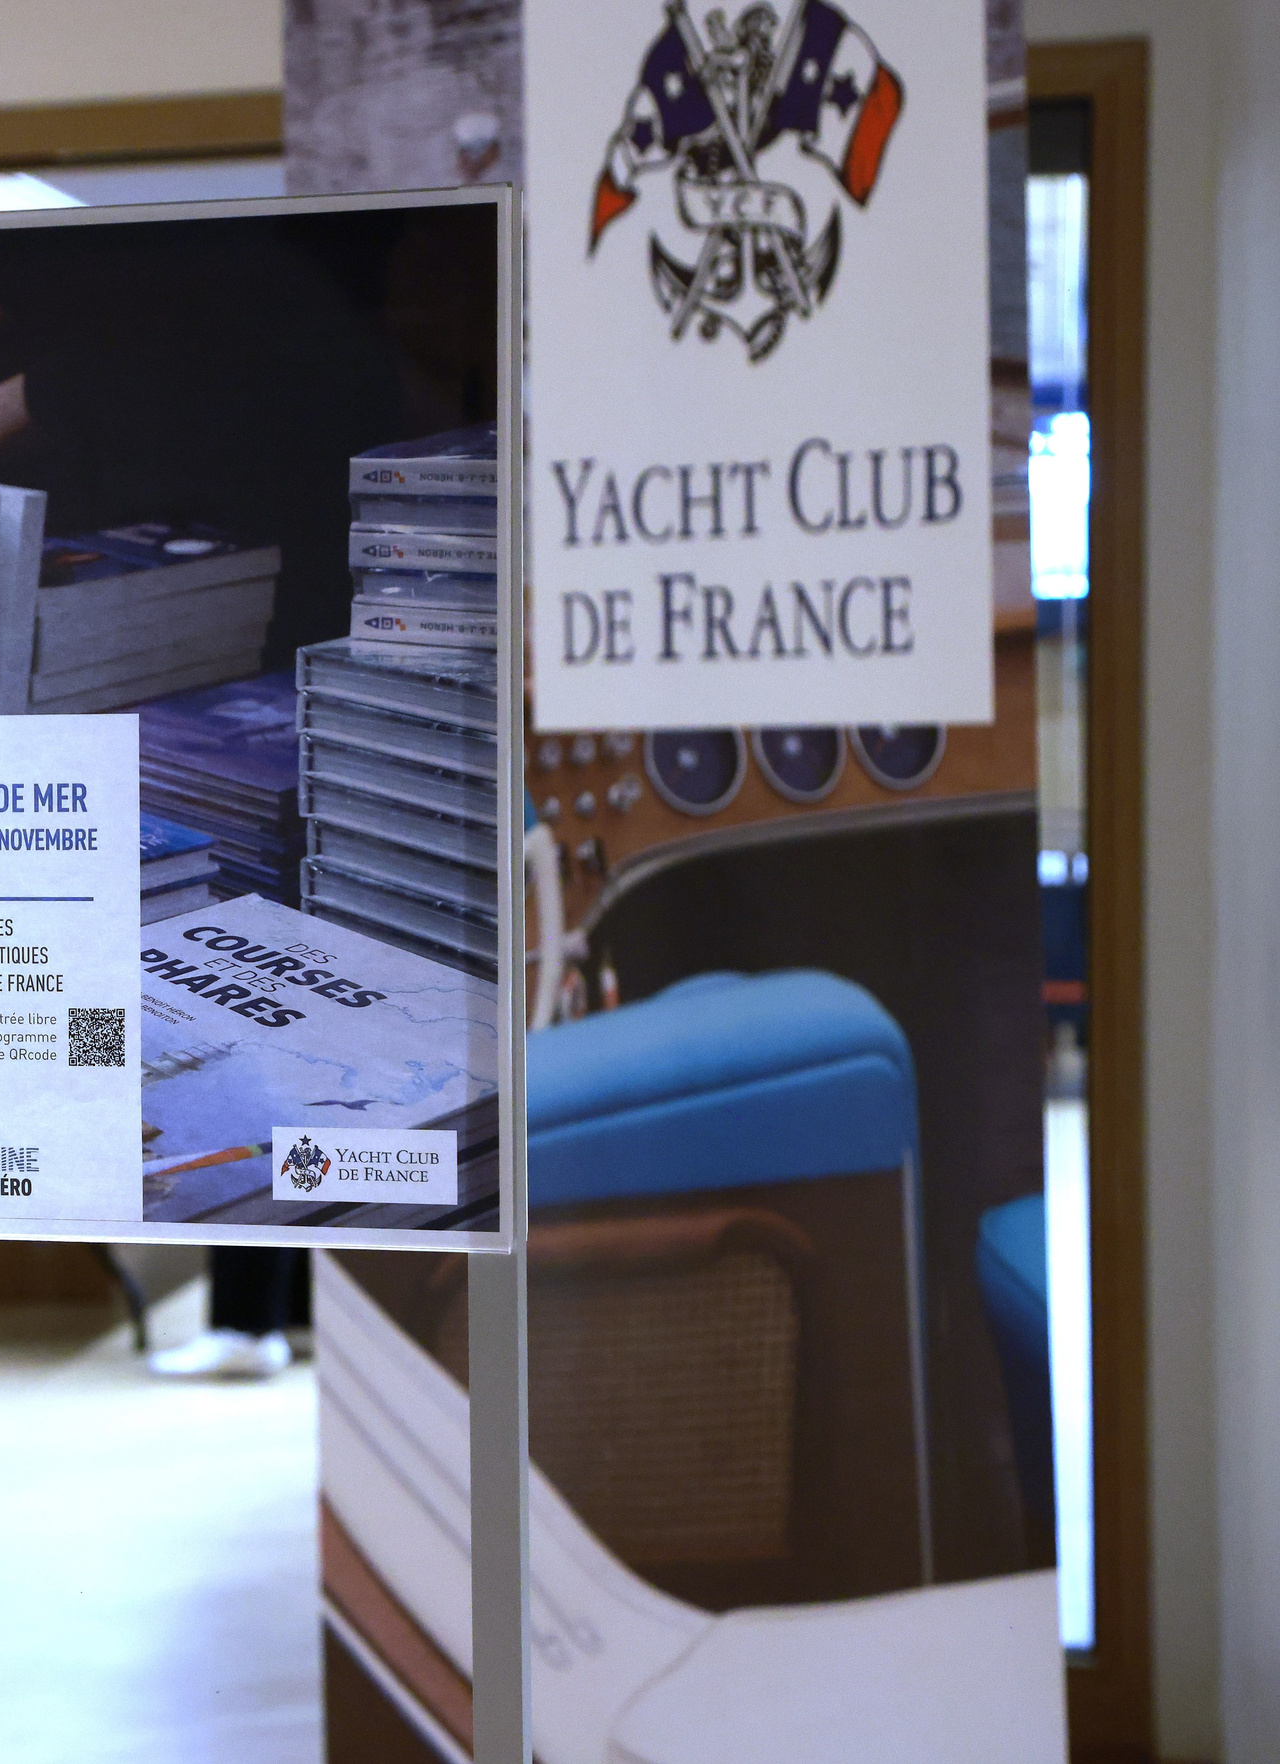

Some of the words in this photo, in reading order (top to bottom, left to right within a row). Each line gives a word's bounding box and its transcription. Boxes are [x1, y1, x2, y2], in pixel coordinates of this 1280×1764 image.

[551, 458, 770, 547] YACHT
[787, 437, 964, 535] CLUB
[562, 590, 634, 666] DE
[656, 572, 914, 663] FRANCE
[34, 783, 88, 813] MER
[284, 943, 337, 964] DES
[183, 926, 387, 1008] COURSES
[204, 957, 242, 972] ET
[232, 970, 286, 993] DES
[7, 974, 63, 992] FRANCE
[28, 1012, 57, 1025] libre
[9, 1049, 57, 1061] QRcode
[335, 1149, 391, 1164] YACHT
[396, 1150, 439, 1164] CLUB
[338, 1169, 358, 1181] DE
[364, 1168, 429, 1183] FRANCE
